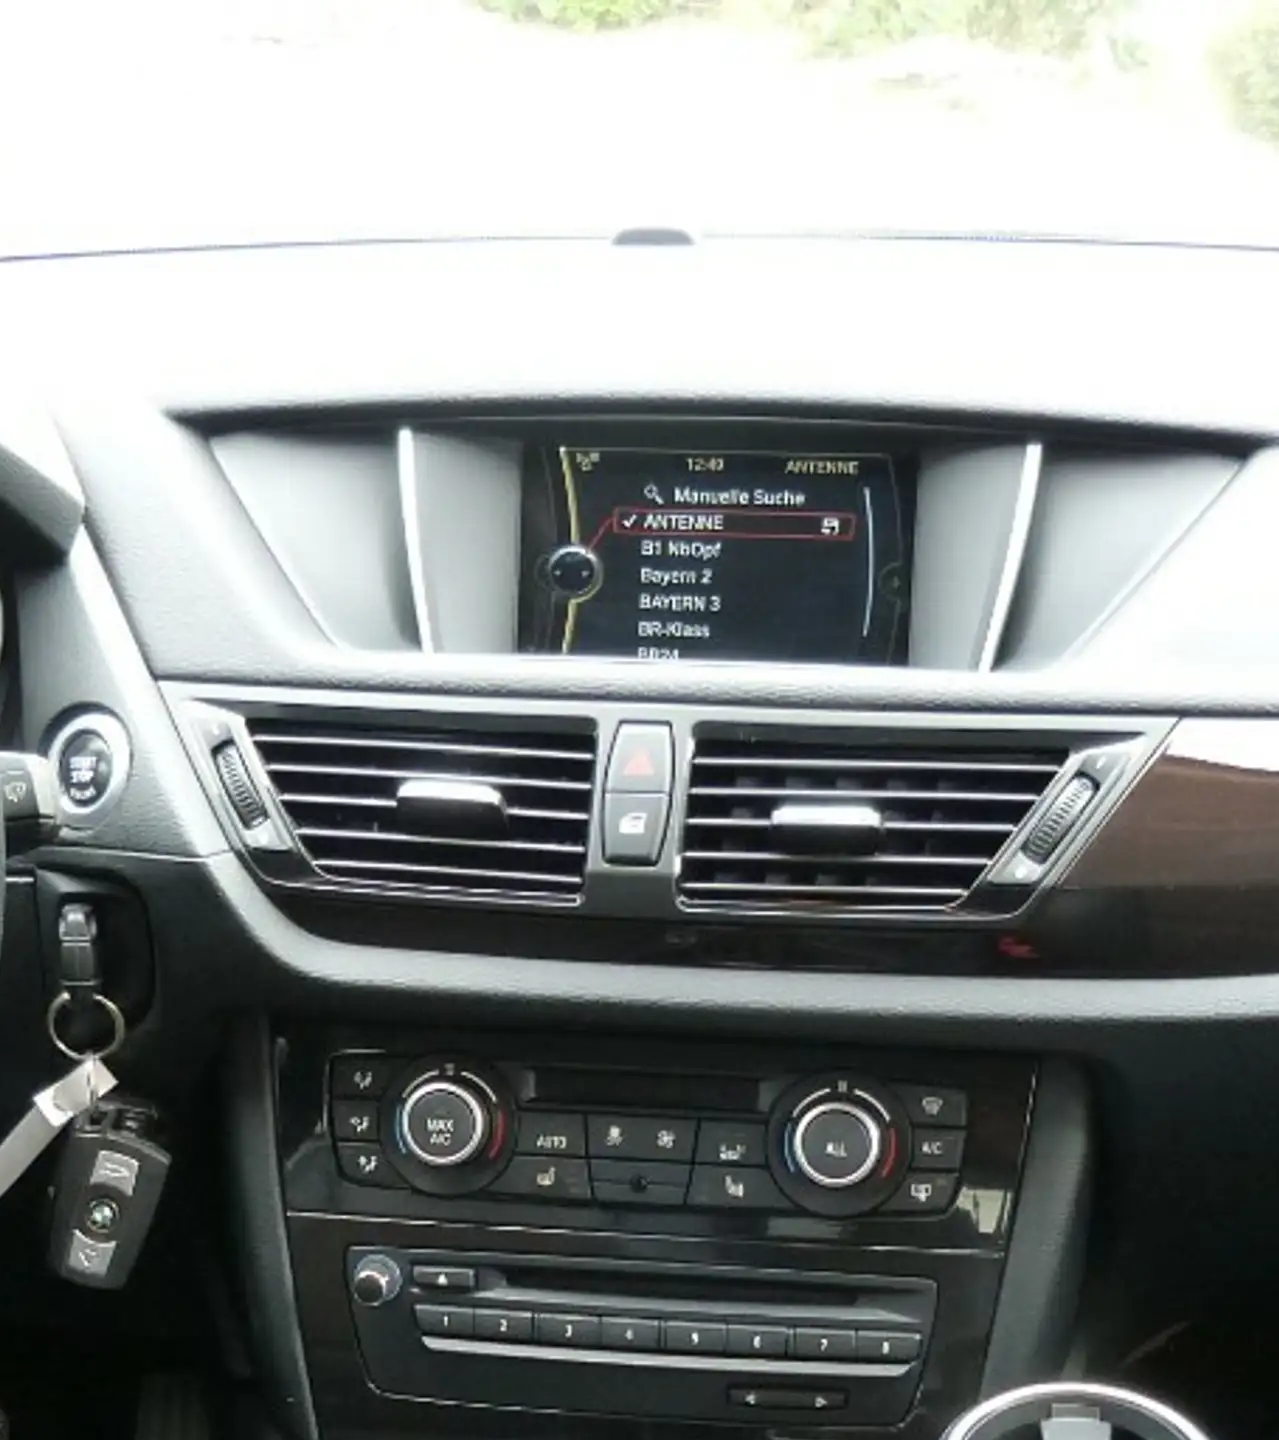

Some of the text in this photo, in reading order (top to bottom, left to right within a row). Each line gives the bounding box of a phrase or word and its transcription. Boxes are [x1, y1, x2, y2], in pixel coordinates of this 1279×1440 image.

[784, 460, 859, 475] ANTENNE
[674, 487, 806, 506] Manuelle Suche
[643, 514, 724, 531] ANTENNE
[641, 539, 662, 556] B1
[640, 567, 713, 588] Bayern 2
[639, 592, 721, 612] BAYERN 3
[426, 1118, 454, 1132] MAX
[430, 1132, 451, 1146] A/C
[536, 1133, 568, 1149] AUTO
[825, 1141, 848, 1158] ALL
[921, 1141, 943, 1155] A/C
